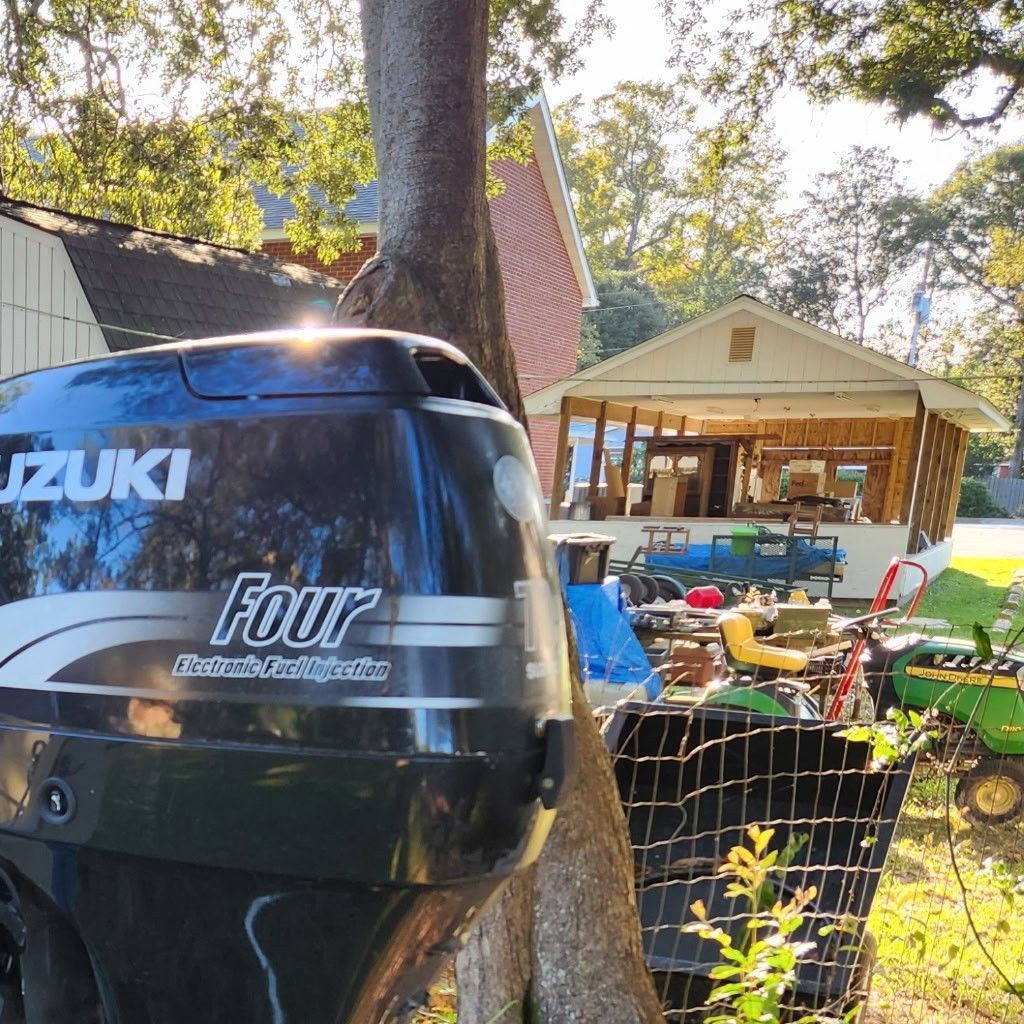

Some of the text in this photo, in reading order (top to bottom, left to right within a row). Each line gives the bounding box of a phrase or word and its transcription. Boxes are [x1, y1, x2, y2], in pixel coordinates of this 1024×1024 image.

[209, 572, 382, 648] Four
[173, 654, 391, 682] Electronic Fuel Injection
[920, 669, 946, 680] JOHN
